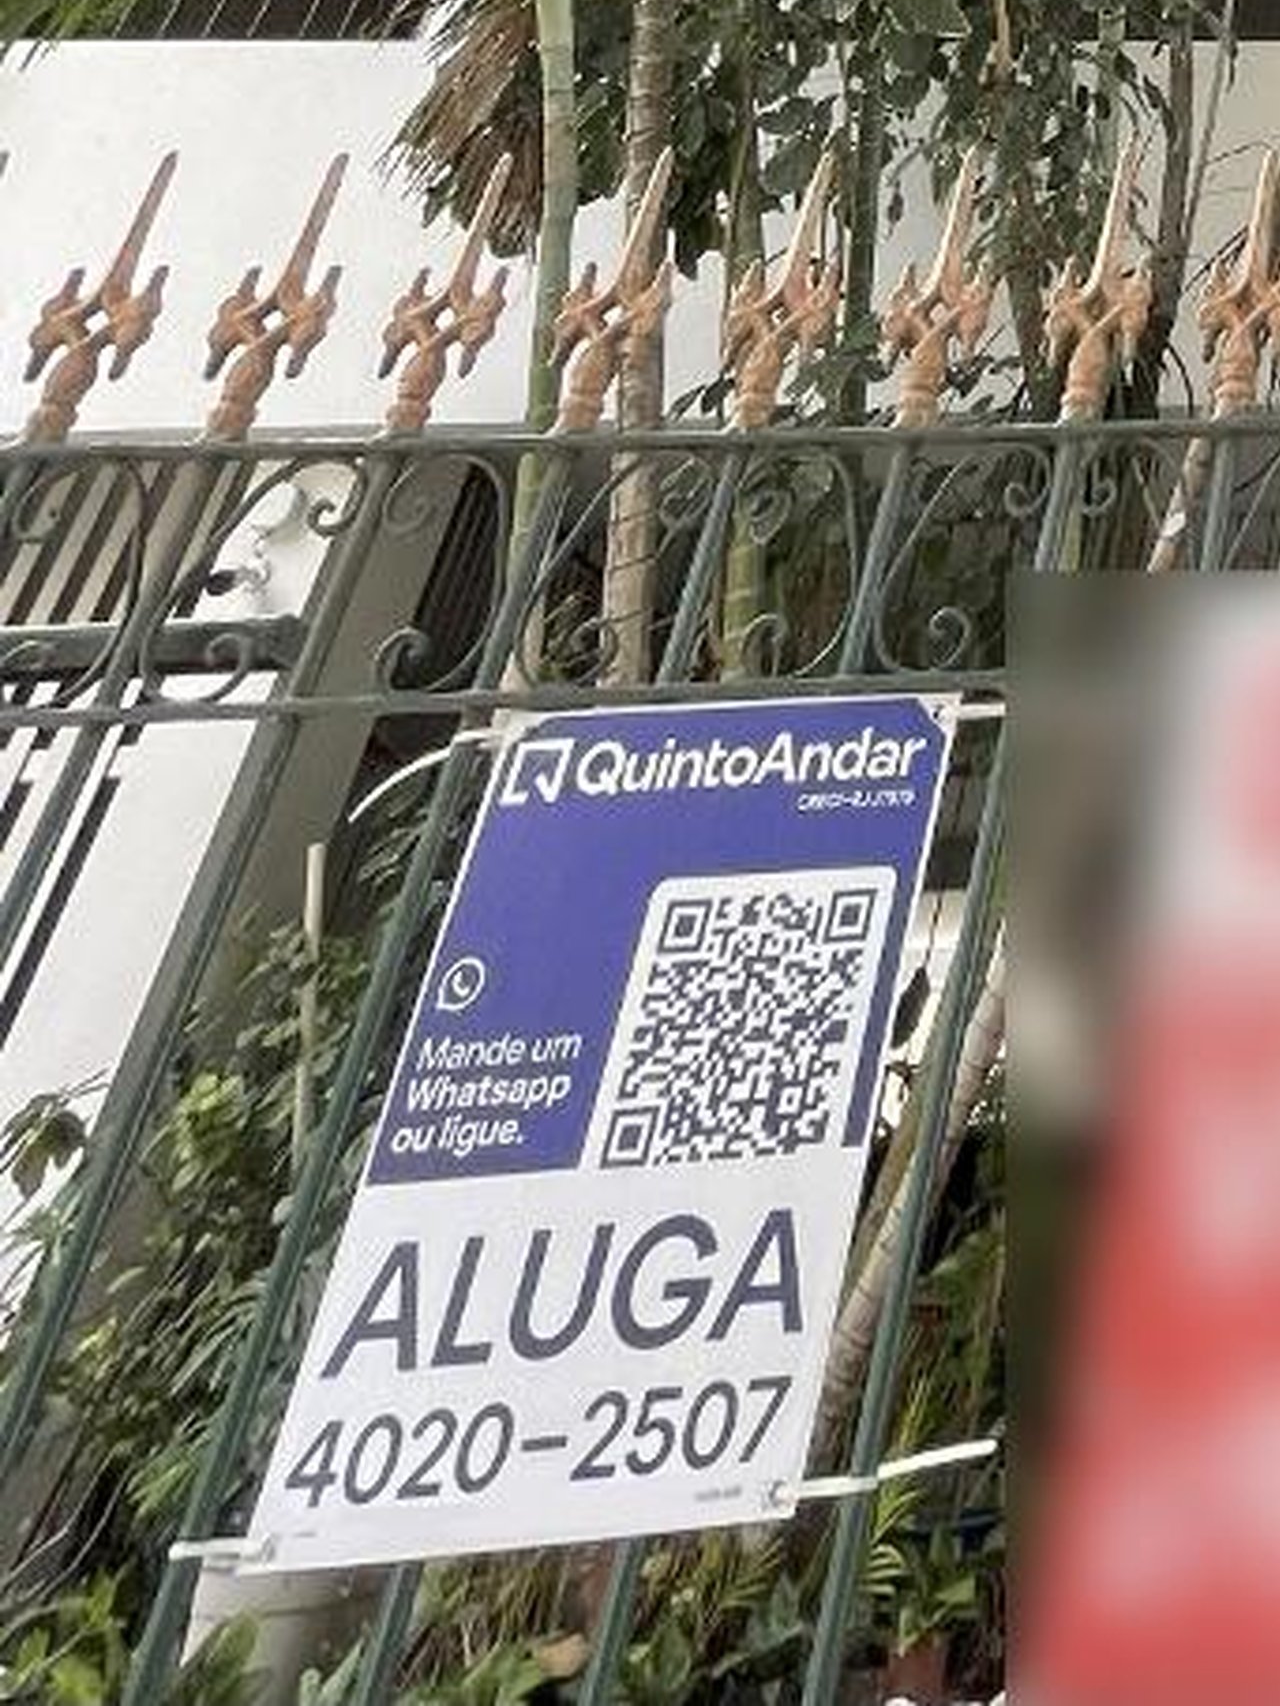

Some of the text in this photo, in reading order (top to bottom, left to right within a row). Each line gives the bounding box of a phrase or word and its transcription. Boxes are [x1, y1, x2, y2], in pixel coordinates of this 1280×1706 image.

[576, 727, 926, 796] QuintoAndar
[415, 1033, 583, 1072] Mande um
[407, 1075, 572, 1112] Whatsapp
[391, 1113, 525, 1158] ou ligue.
[320, 1209, 803, 1380] ALUGA
[285, 1376, 793, 1508] 4020-2507
